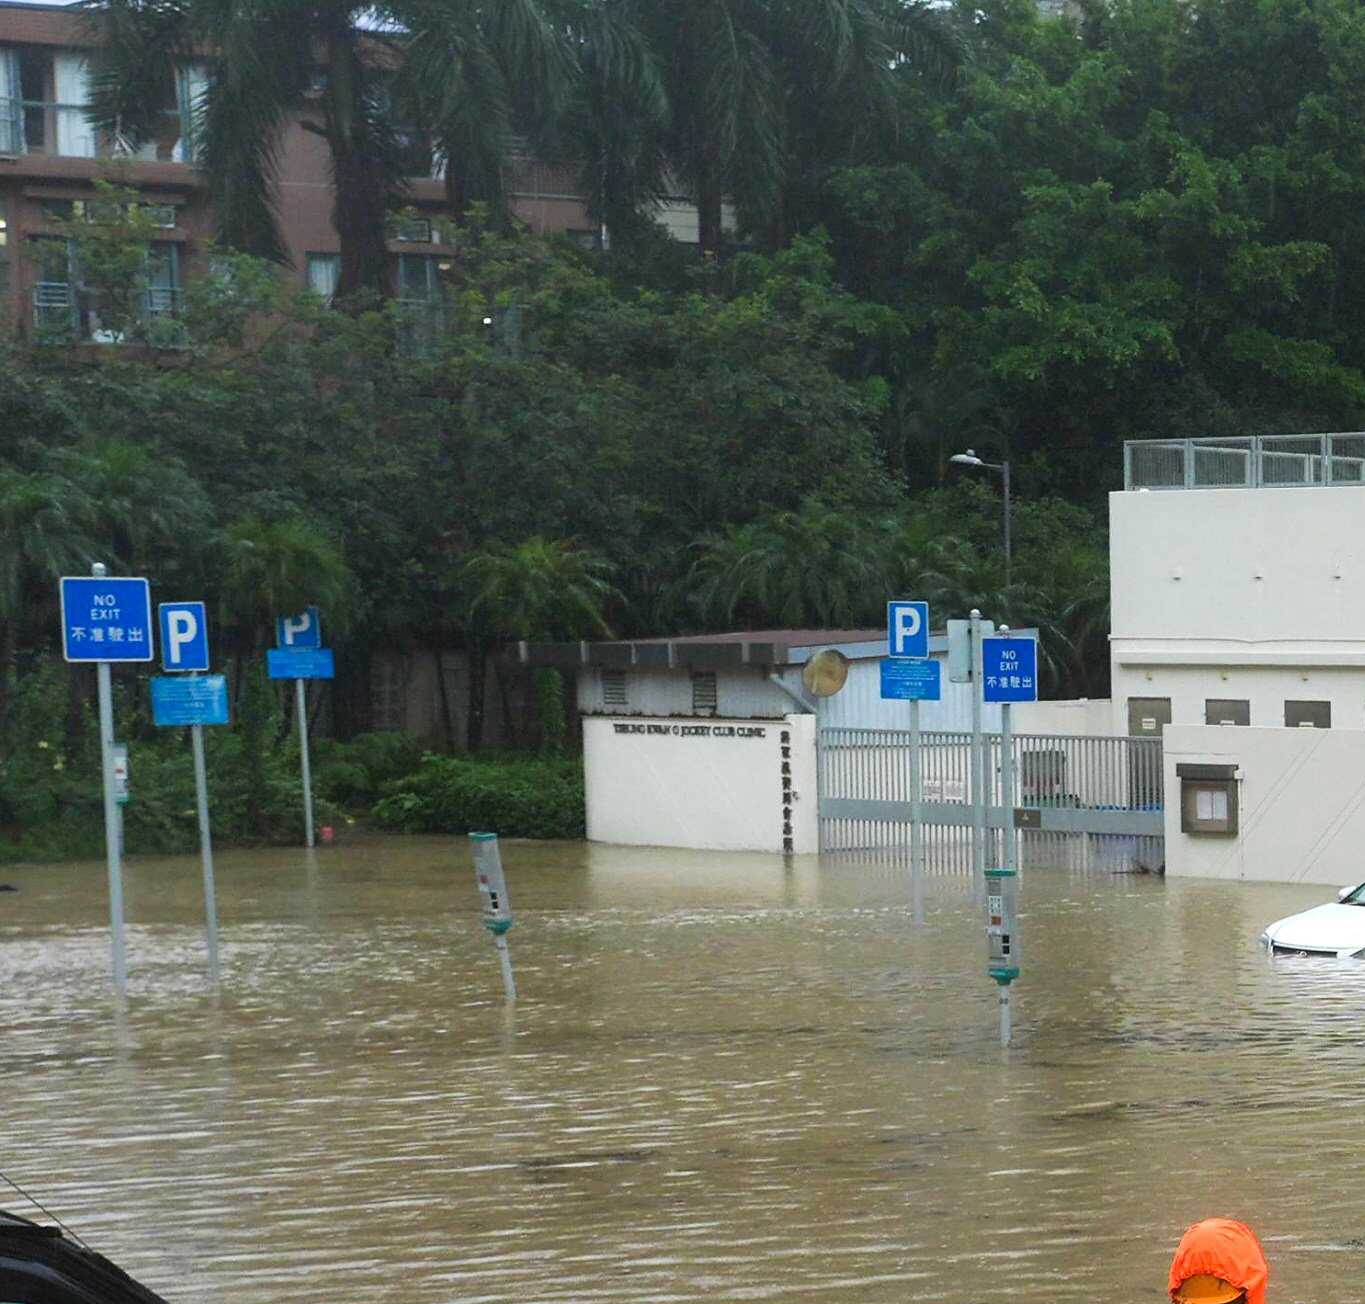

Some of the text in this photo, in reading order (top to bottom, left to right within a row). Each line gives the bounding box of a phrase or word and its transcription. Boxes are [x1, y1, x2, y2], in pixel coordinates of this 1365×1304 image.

[94, 594, 116, 606] NO
[90, 608, 120, 620] EXIT
[71, 627, 143, 642] 不准駛出
[283, 612, 311, 645] P
[895, 607, 921, 653] P
[167, 610, 197, 663] P
[1002, 650, 1017, 660] NO
[1000, 661, 1019, 671] EXIT
[986, 676, 1033, 688] 不准駛出
